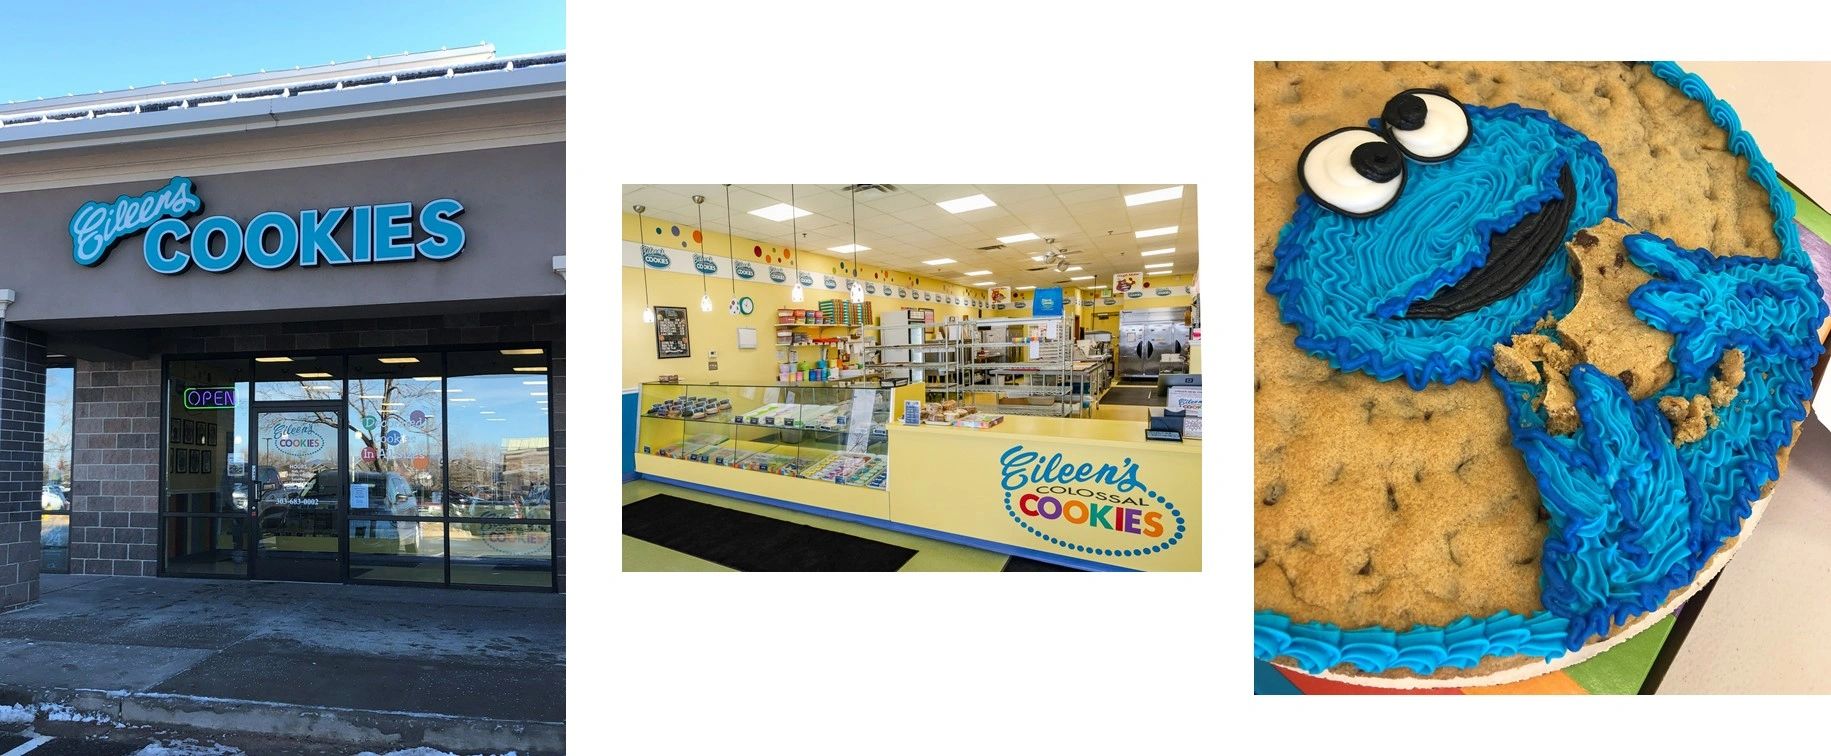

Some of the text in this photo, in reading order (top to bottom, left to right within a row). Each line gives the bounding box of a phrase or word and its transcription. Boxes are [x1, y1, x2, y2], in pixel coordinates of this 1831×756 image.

[143, 199, 466, 274] COOKIES
[188, 391, 238, 405] OPEN
[279, 439, 320, 447] COOKIES
[363, 448, 375, 459] In
[1000, 444, 1147, 492] Eileen's
[1036, 485, 1150, 507] COLOSSAL
[1019, 493, 1164, 538] COOKIES
